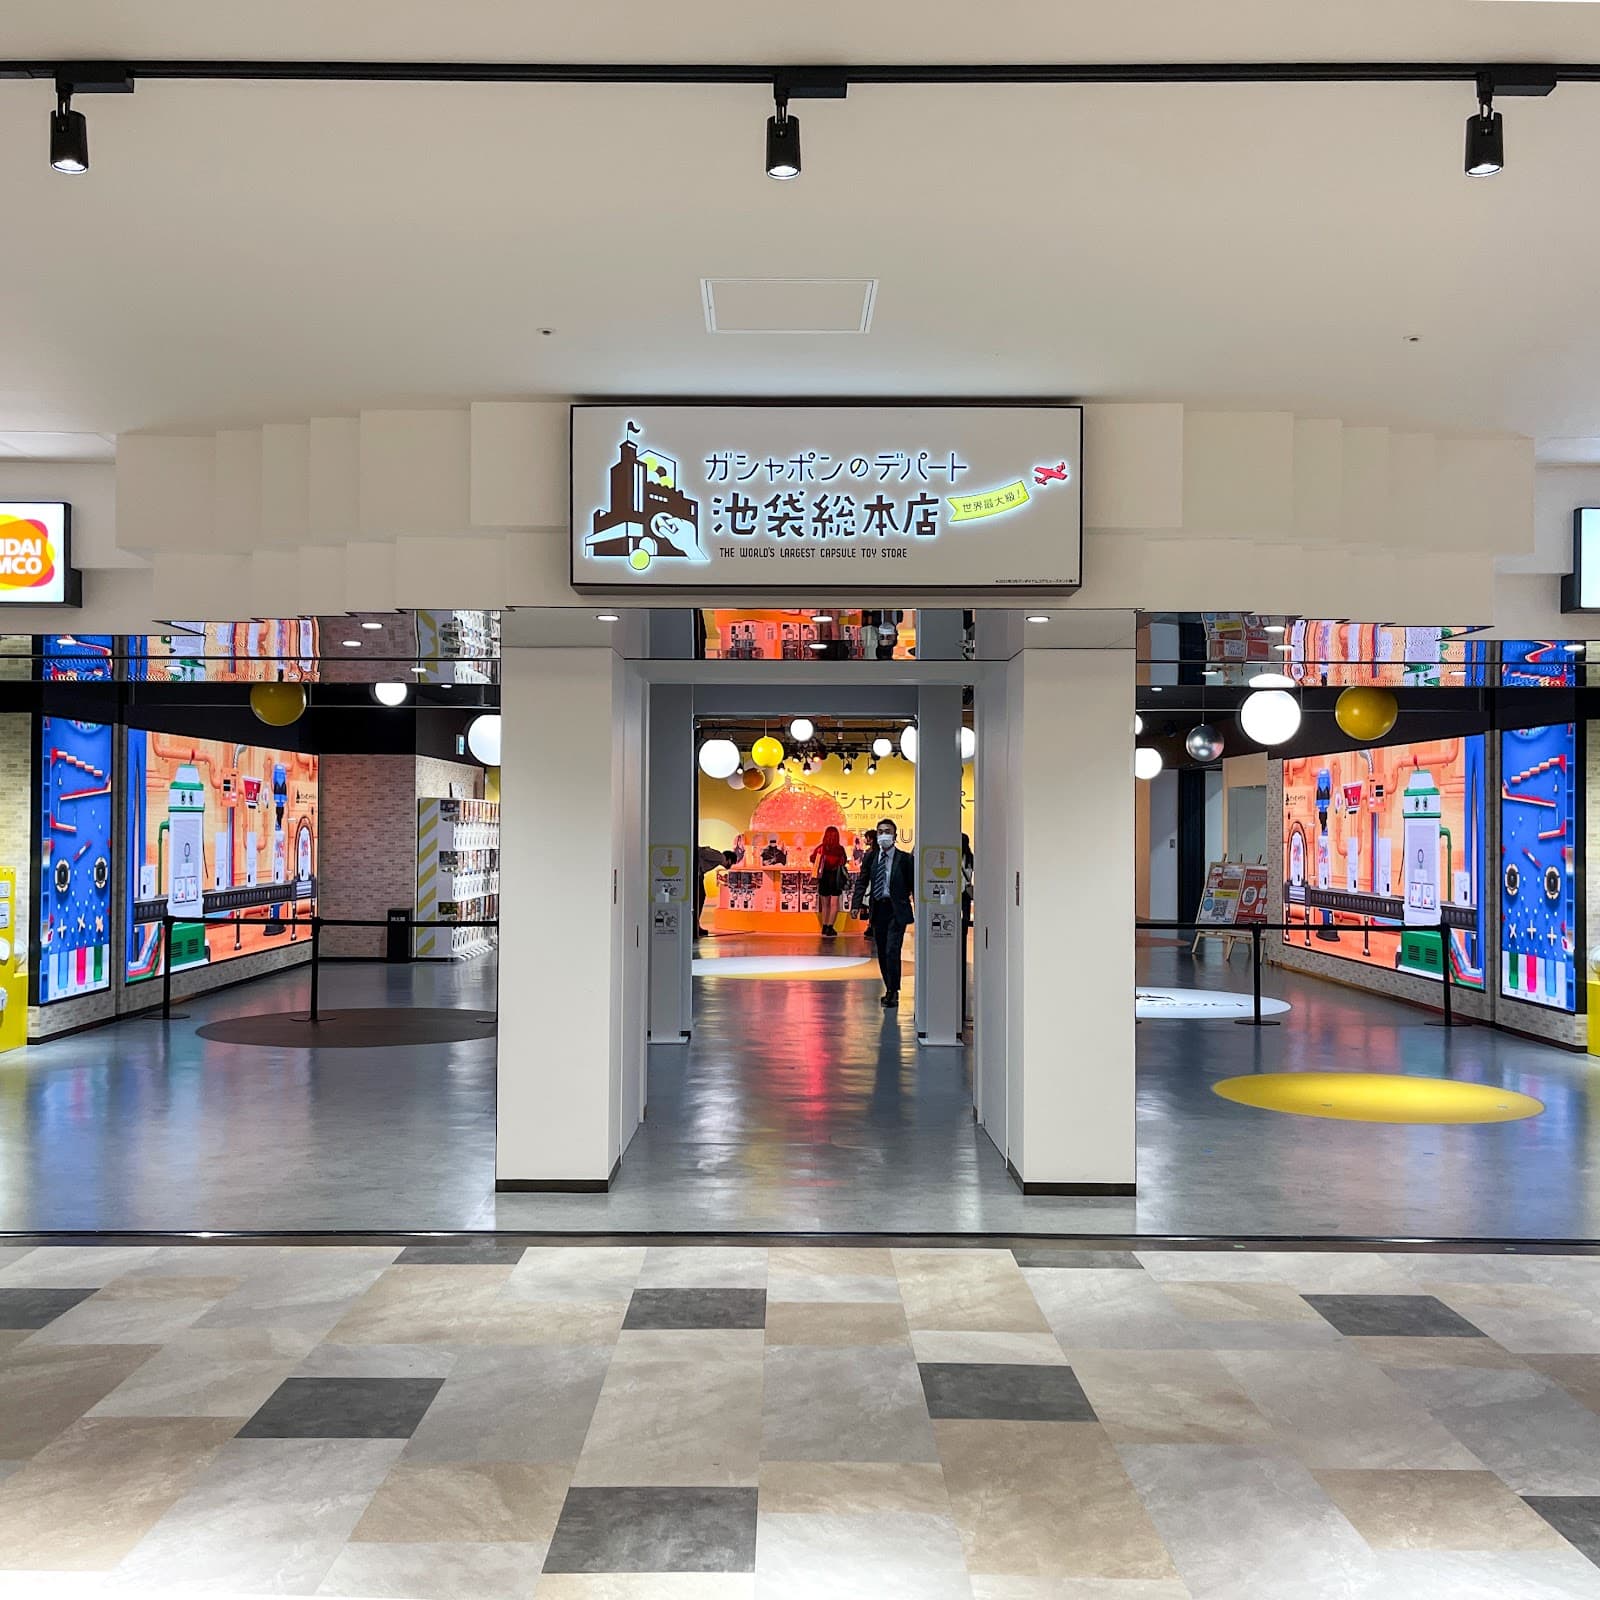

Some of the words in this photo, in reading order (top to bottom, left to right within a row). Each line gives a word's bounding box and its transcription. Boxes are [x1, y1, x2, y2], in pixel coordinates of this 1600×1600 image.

[705, 452, 967, 482] ガシャポンのデパート
[713, 491, 940, 539] 池袋総本店
[0, 538, 42, 555] DAI
[719, 547, 734, 558] THE
[739, 546, 775, 558] WORLD'S
[780, 548, 815, 558] LARGEST
[820, 548, 856, 558] CAPSULE
[861, 548, 878, 558] TOY
[881, 548, 907, 558] STORE
[833, 790, 911, 811] シャポン
